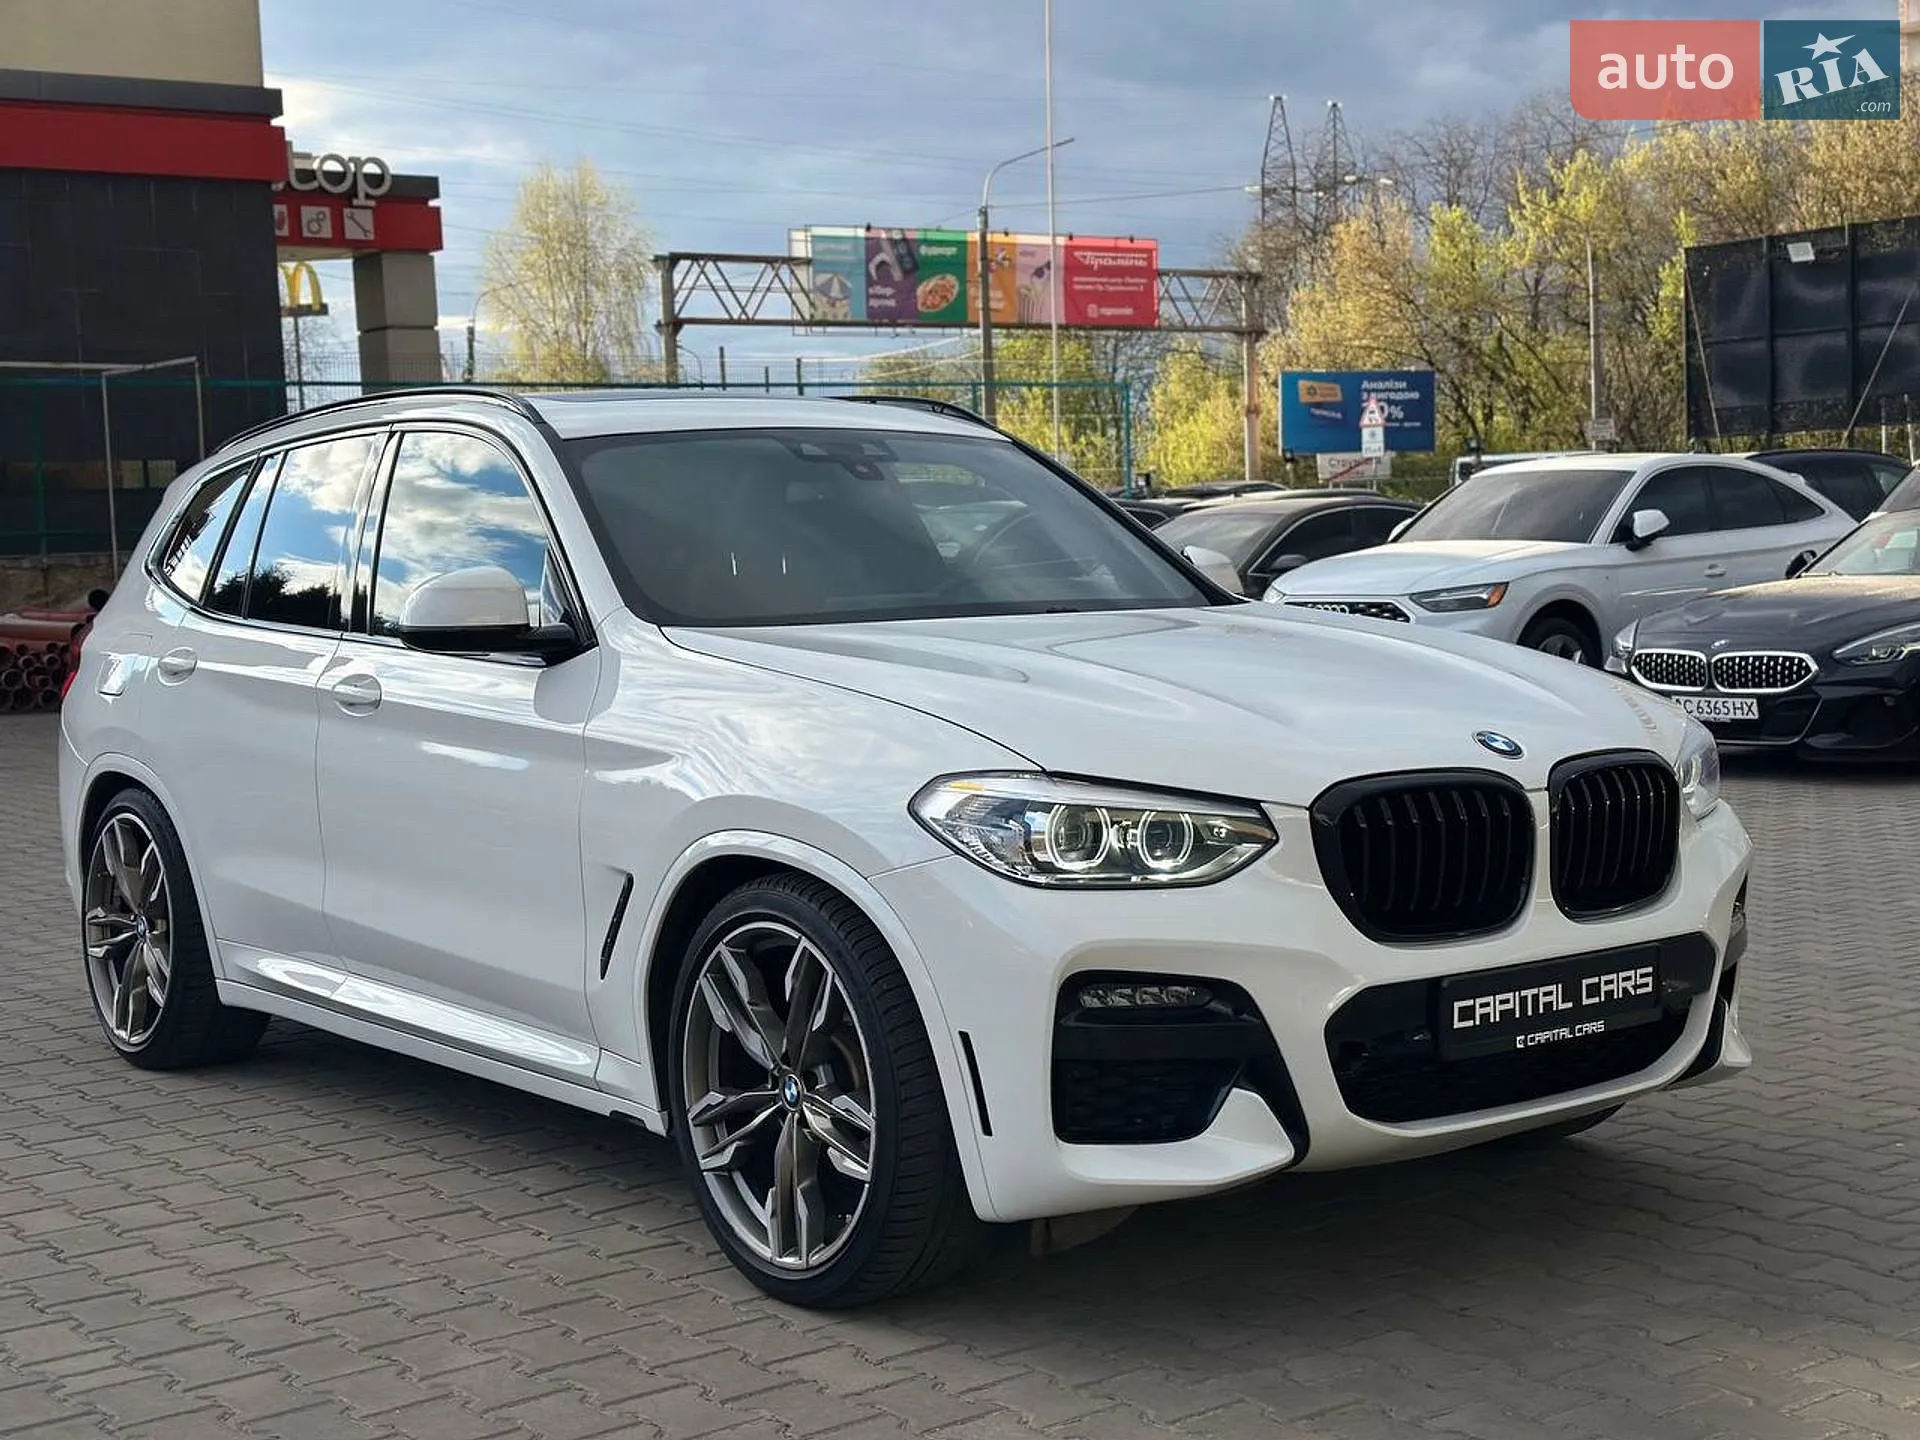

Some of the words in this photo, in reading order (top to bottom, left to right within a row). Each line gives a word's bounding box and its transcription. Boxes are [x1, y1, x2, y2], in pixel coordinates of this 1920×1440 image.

[272, 141, 391, 206] top
[1361, 379, 1407, 389] Аналізи
[1696, 700, 1730, 715] 6365
[1732, 701, 1756, 716] HX
[1453, 983, 1573, 1029] CAPITAL
[1581, 966, 1653, 1005] CARS
[1527, 1024, 1573, 1046] CAPITAL
[1575, 1020, 1605, 1037] CARS
